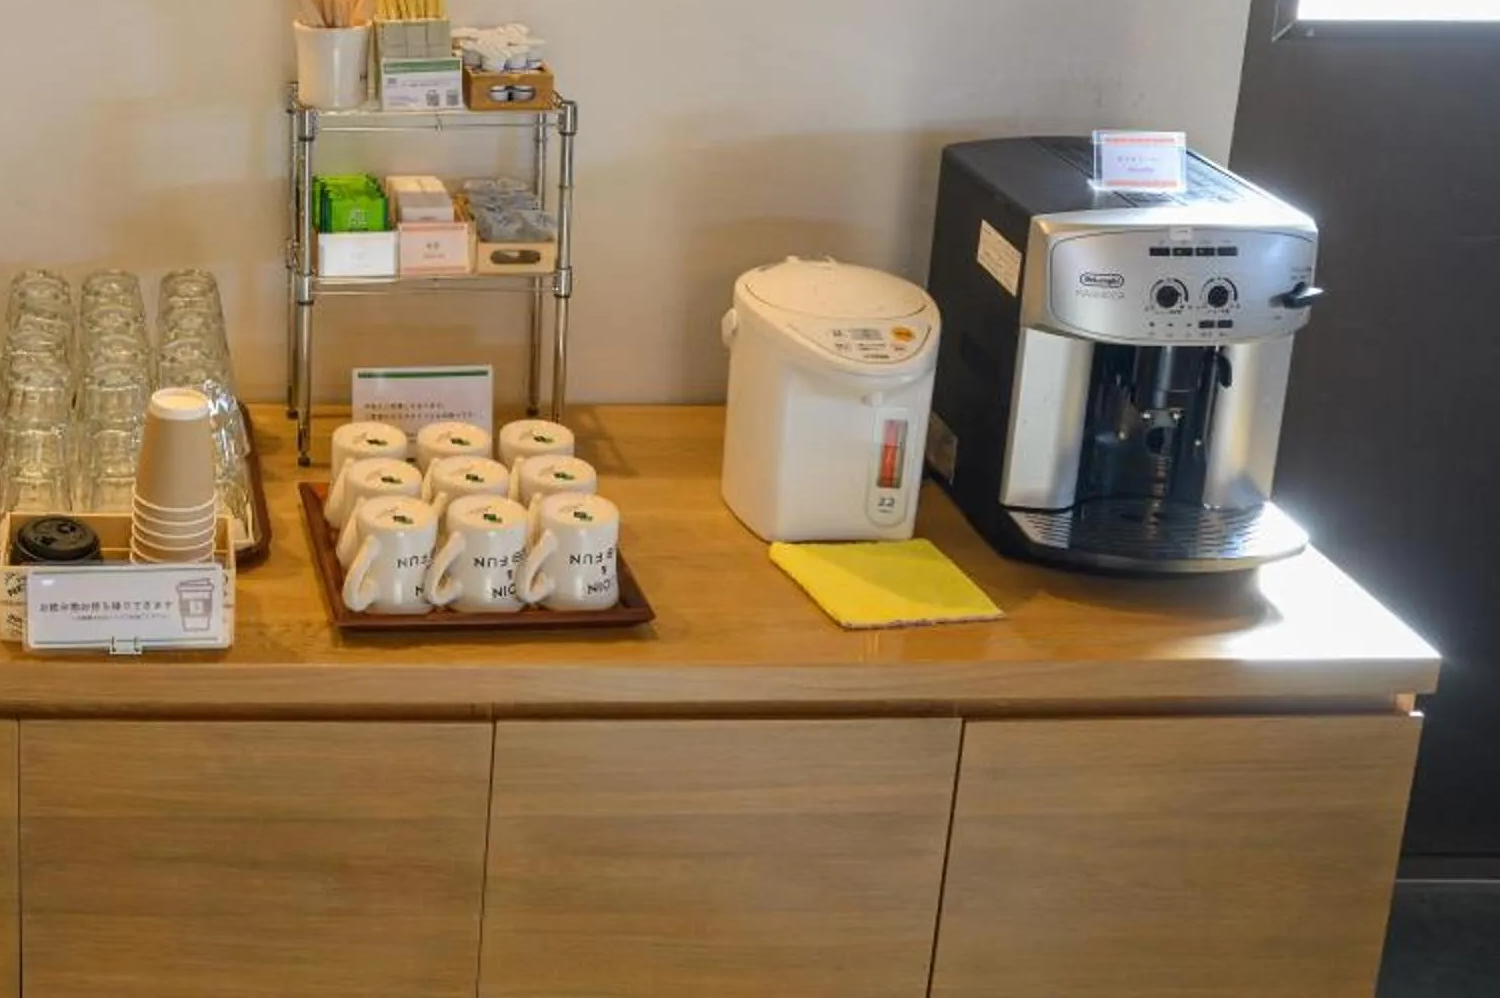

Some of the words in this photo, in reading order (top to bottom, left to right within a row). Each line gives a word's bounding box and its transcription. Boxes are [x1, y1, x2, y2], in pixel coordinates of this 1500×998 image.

[473, 554, 509, 568] FUN
[569, 552, 603, 566] FUN
[492, 585, 516, 599] OIN
